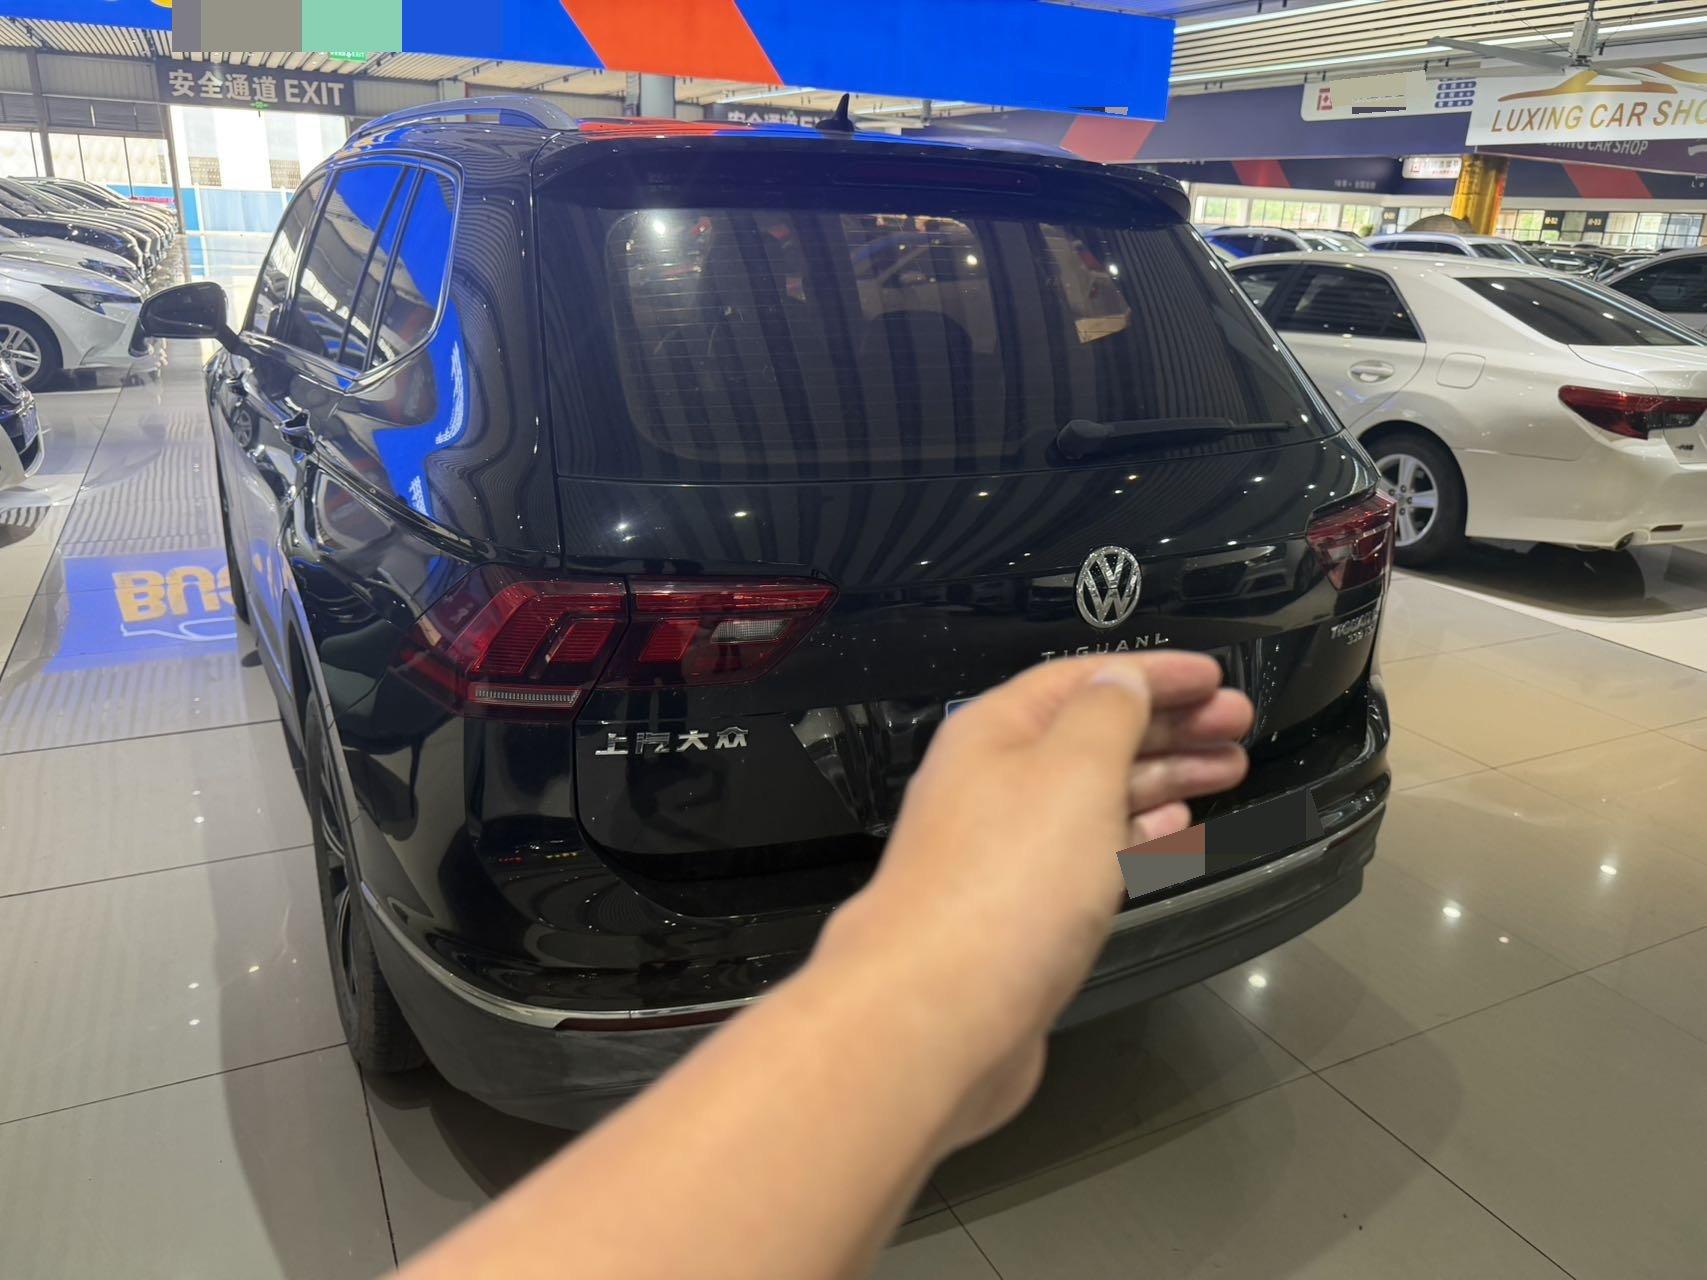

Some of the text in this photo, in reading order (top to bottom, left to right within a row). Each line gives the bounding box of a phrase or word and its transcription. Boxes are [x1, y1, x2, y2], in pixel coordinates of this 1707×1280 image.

[168, 69, 345, 106] 安全通道 EXIT
[1491, 104, 1584, 133] LUXING
[1589, 101, 1648, 129] CAR
[1612, 140, 1649, 155] SHOP
[595, 726, 748, 756] 上汽大众
